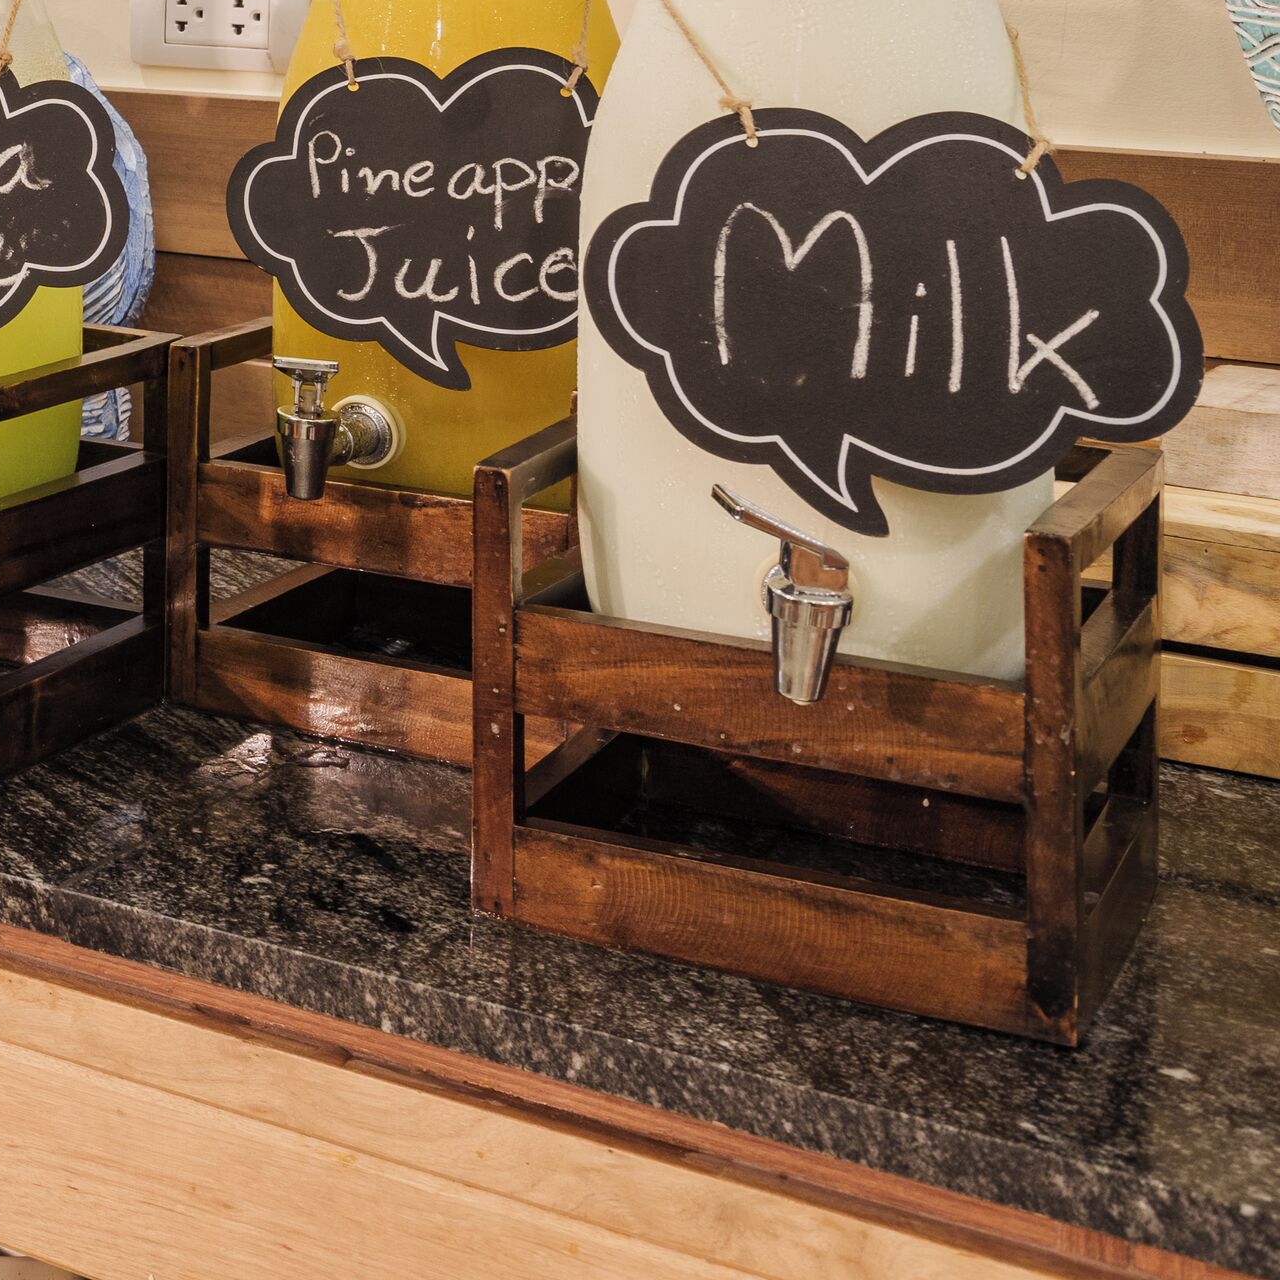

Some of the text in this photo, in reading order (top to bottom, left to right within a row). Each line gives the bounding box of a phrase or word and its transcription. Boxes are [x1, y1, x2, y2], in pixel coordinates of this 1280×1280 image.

[307, 130, 580, 231] Pineapp
[328, 223, 579, 304] Juice
[712, 201, 1100, 410] Milk
